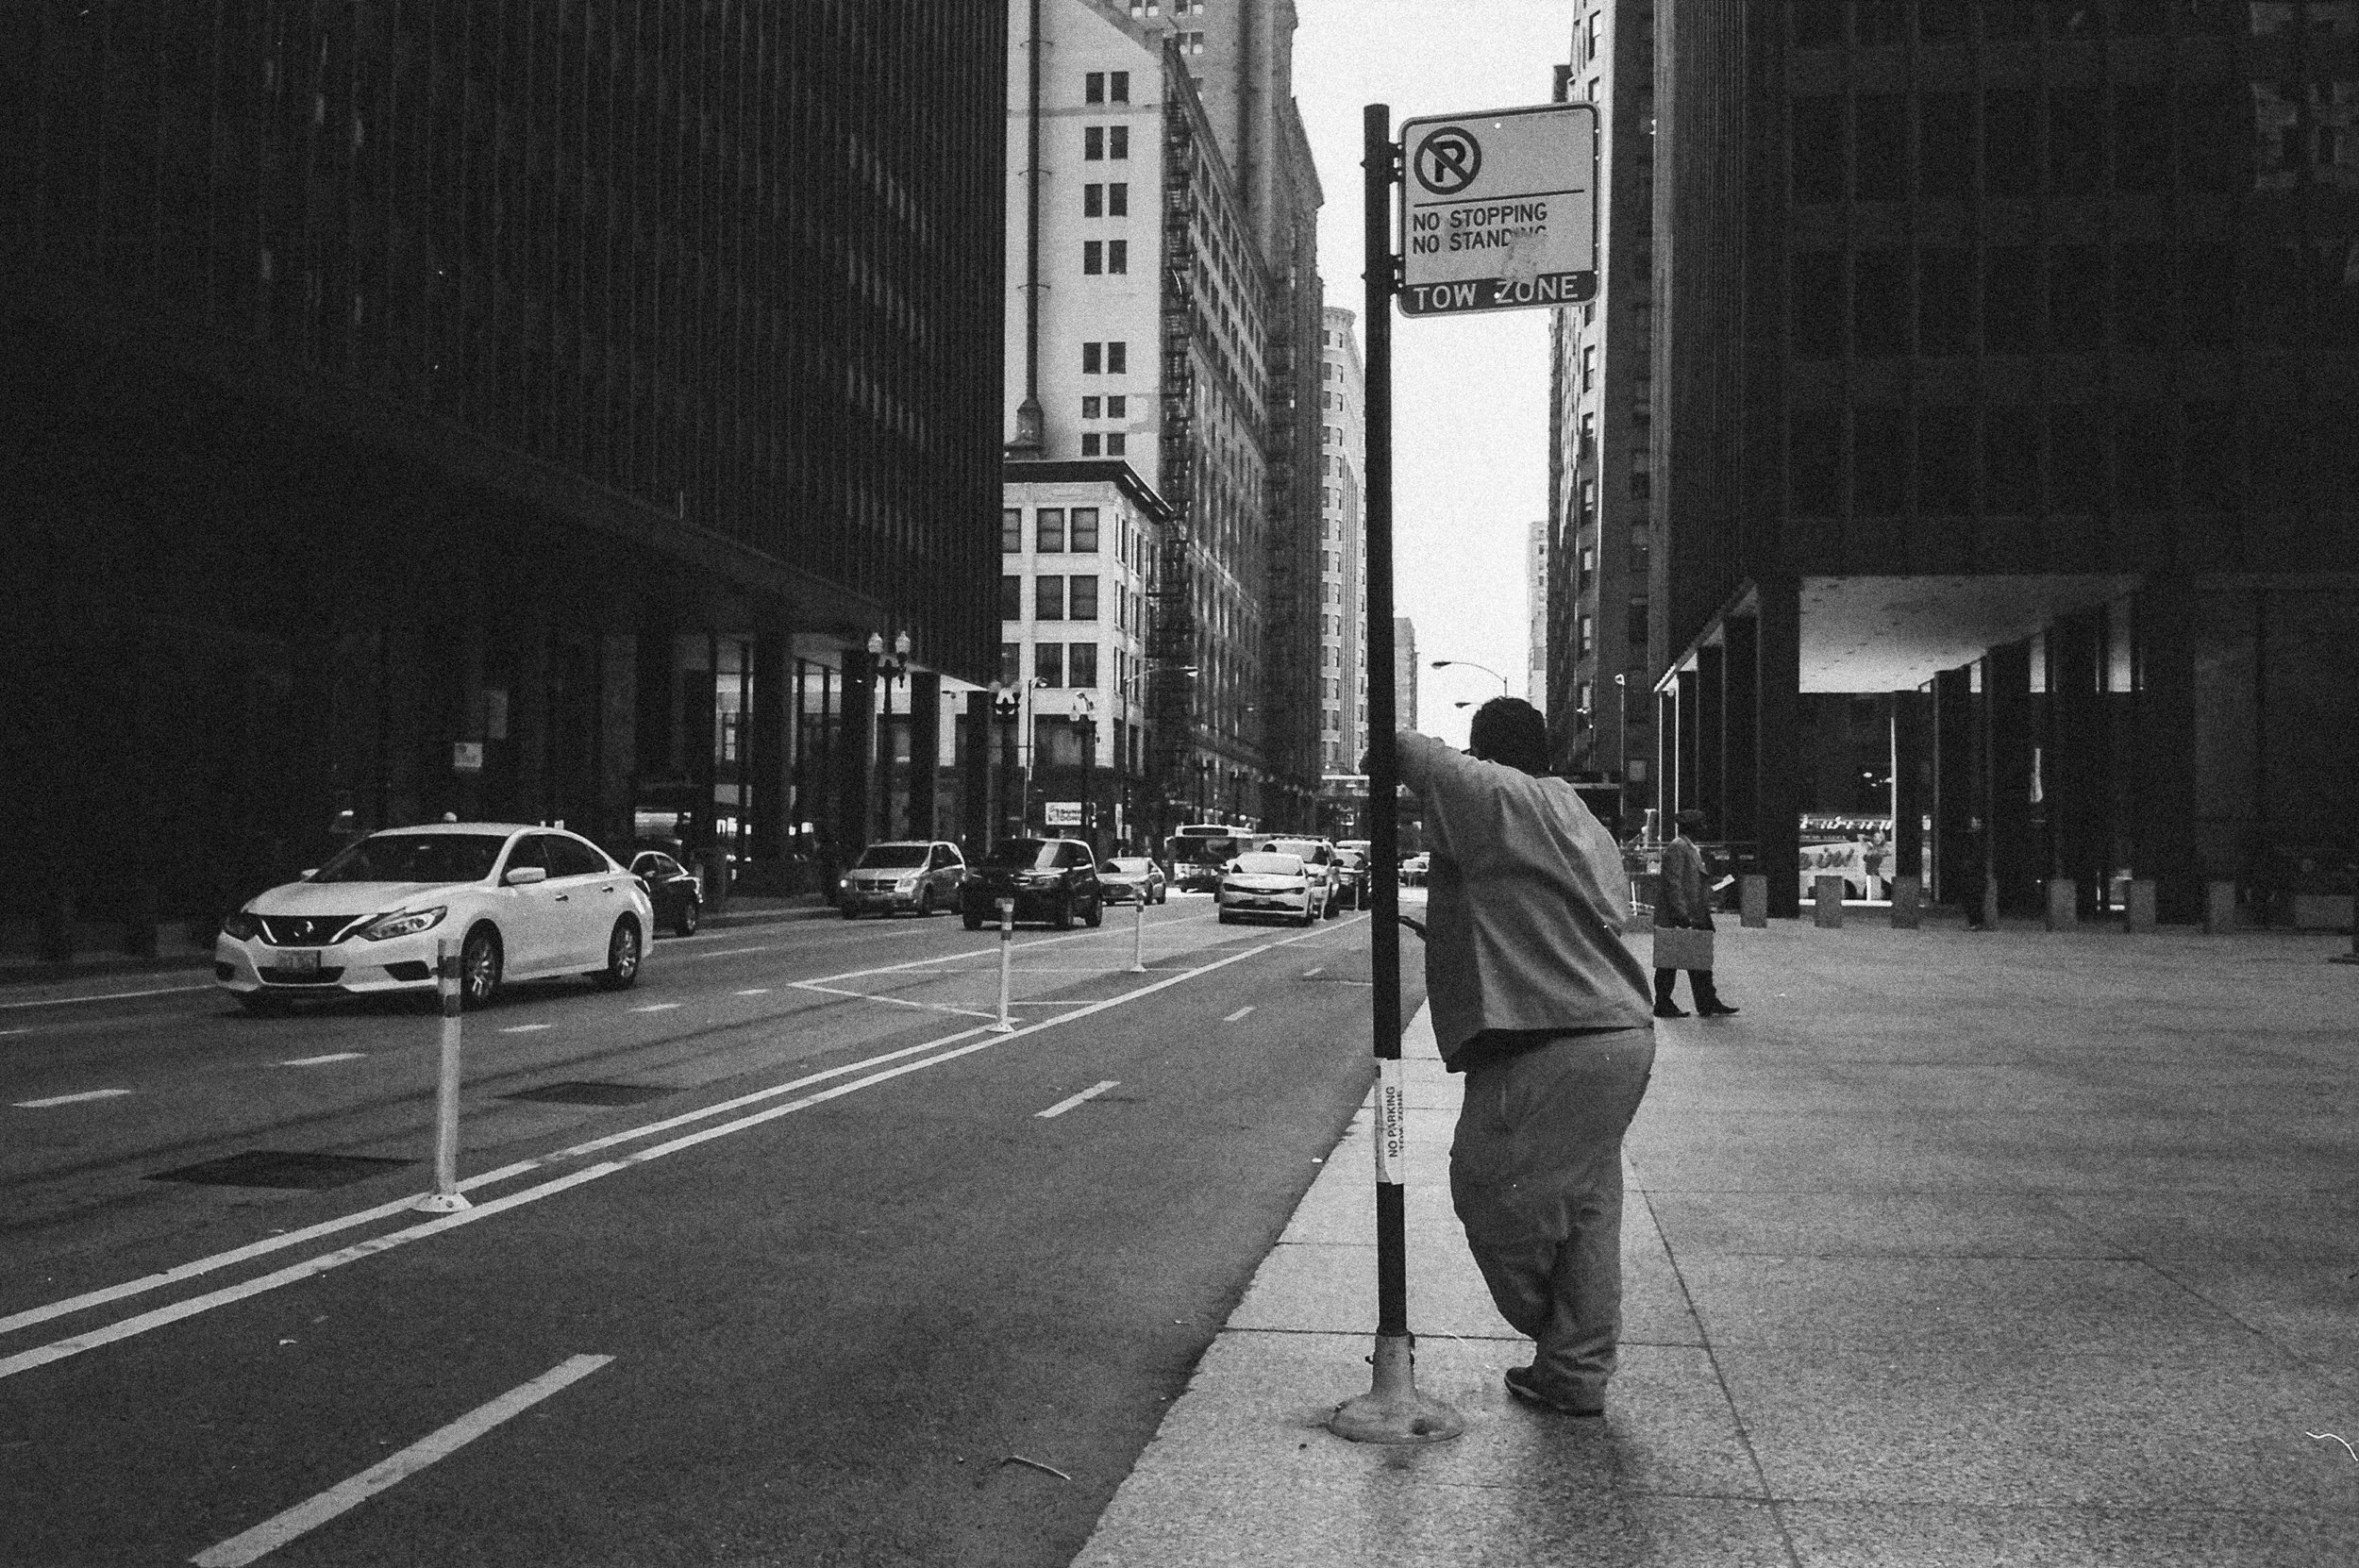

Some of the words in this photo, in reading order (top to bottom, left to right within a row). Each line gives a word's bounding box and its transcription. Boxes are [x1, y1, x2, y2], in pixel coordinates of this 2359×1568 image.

[1413, 211, 1440, 232] NO
[1449, 203, 1548, 227] STOPPING
[1413, 234, 1440, 255] NO
[1449, 225, 1548, 252] STAND
[1414, 283, 1477, 310] TOW
[1495, 275, 1579, 305] ZONE
[1386, 1086, 1397, 1137] PARKING
[1388, 1141, 1397, 1158] NO
